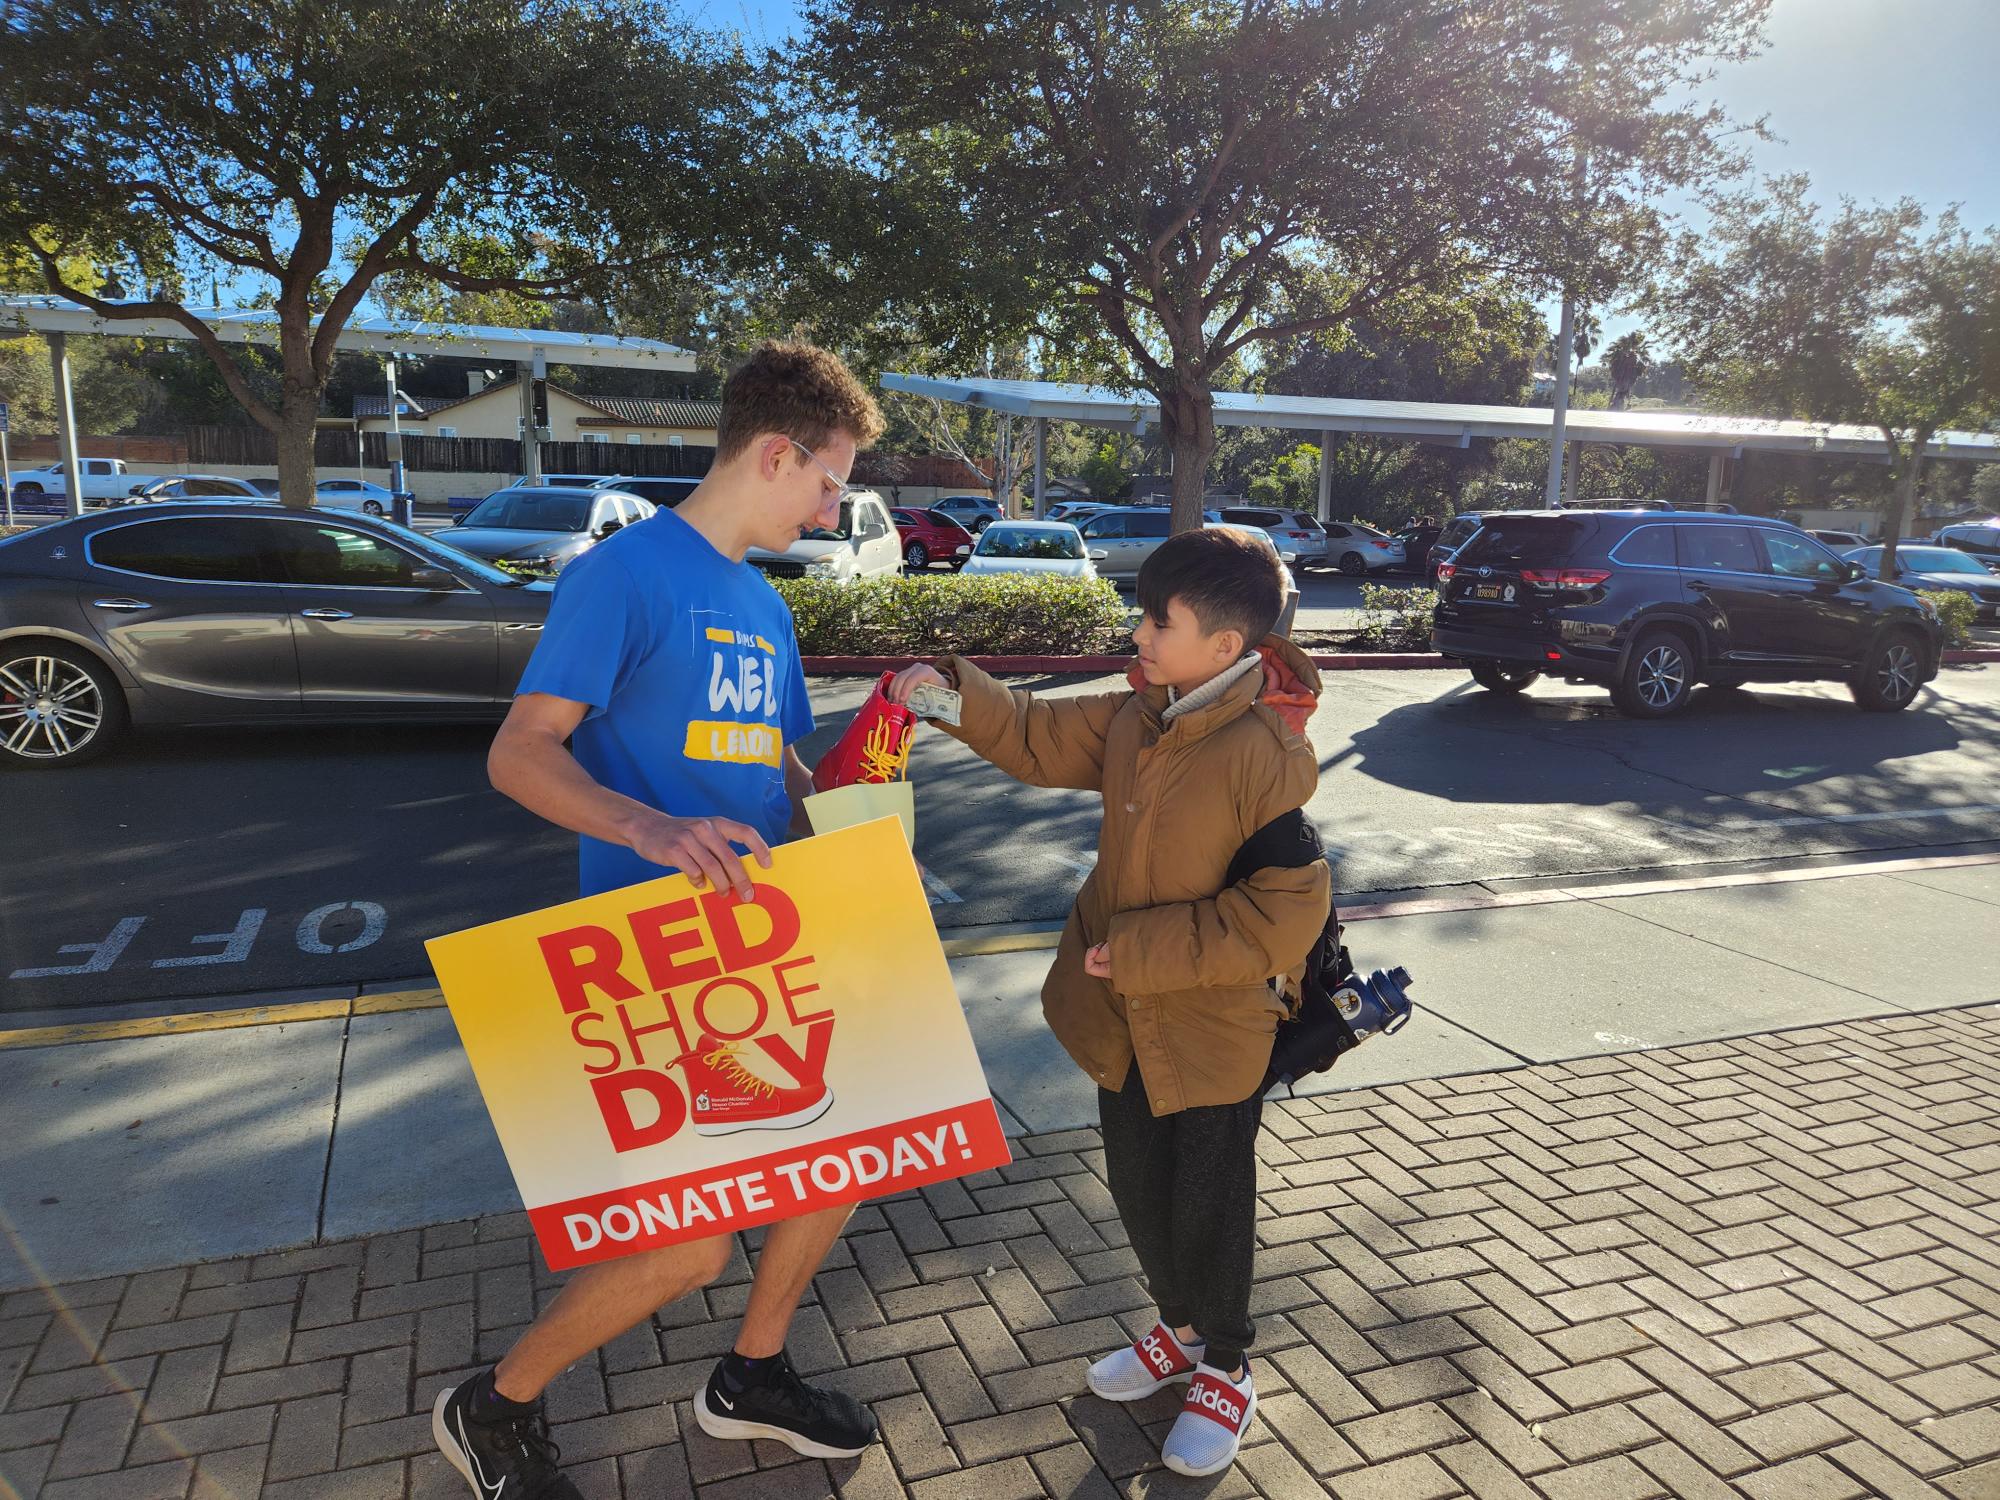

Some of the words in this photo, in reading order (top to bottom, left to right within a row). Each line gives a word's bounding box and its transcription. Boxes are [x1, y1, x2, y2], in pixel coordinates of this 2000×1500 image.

[9, 901, 390, 980] OFF
[537, 882, 801, 1015] RED
[571, 955, 836, 1075] SHOE
[589, 1018, 836, 1154] DY
[563, 1171, 775, 1252] DONATE
[774, 1121, 973, 1200] TODAY!
[1142, 1335, 1174, 1375] das
[1186, 1382, 1241, 1425] didas
